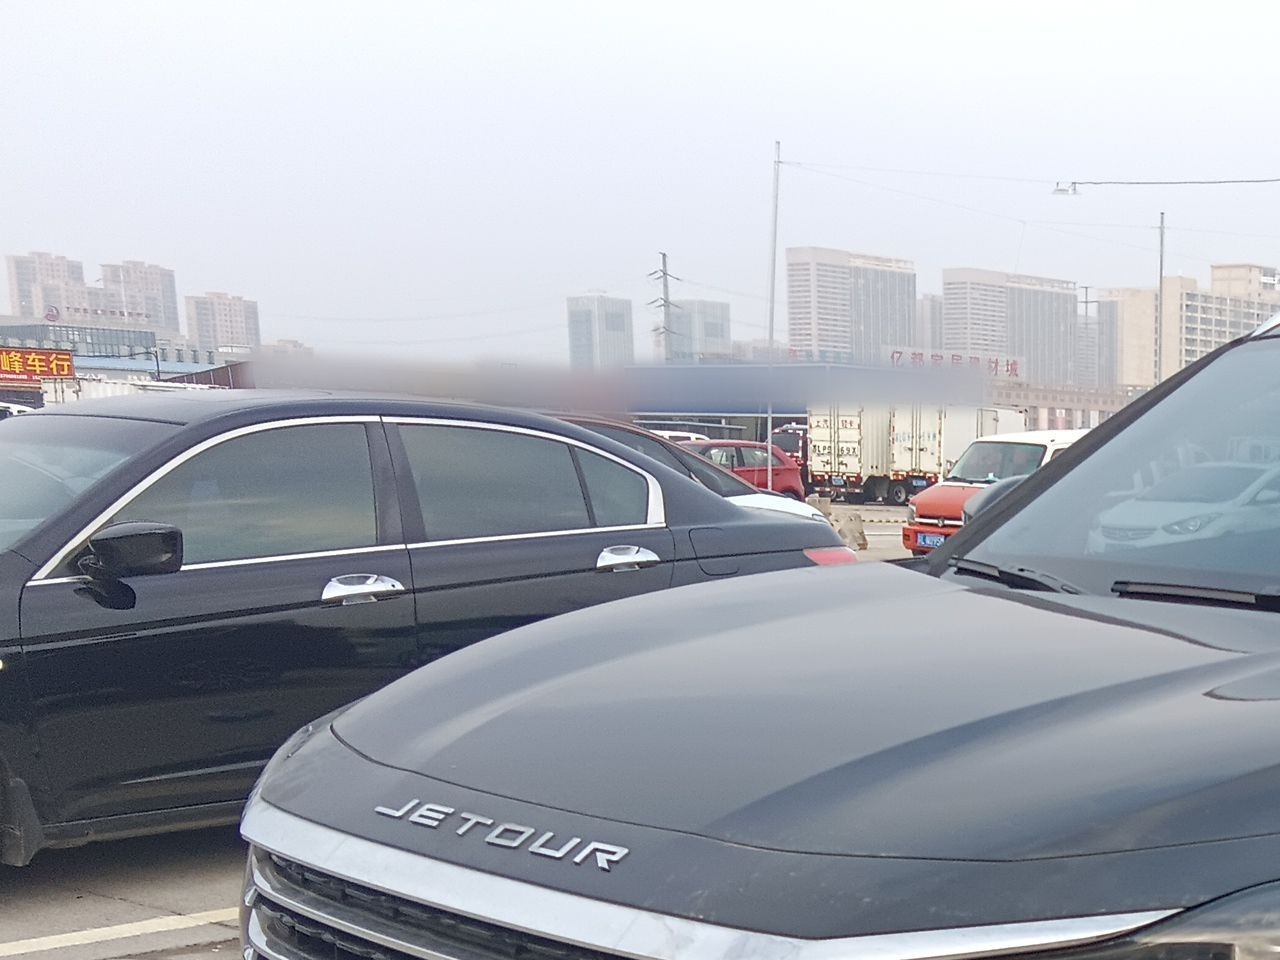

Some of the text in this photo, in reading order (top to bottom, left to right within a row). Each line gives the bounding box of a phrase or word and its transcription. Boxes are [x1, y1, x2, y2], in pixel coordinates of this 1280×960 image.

[0, 351, 71, 374] 峰车行
[374, 799, 629, 872] JETOUR
